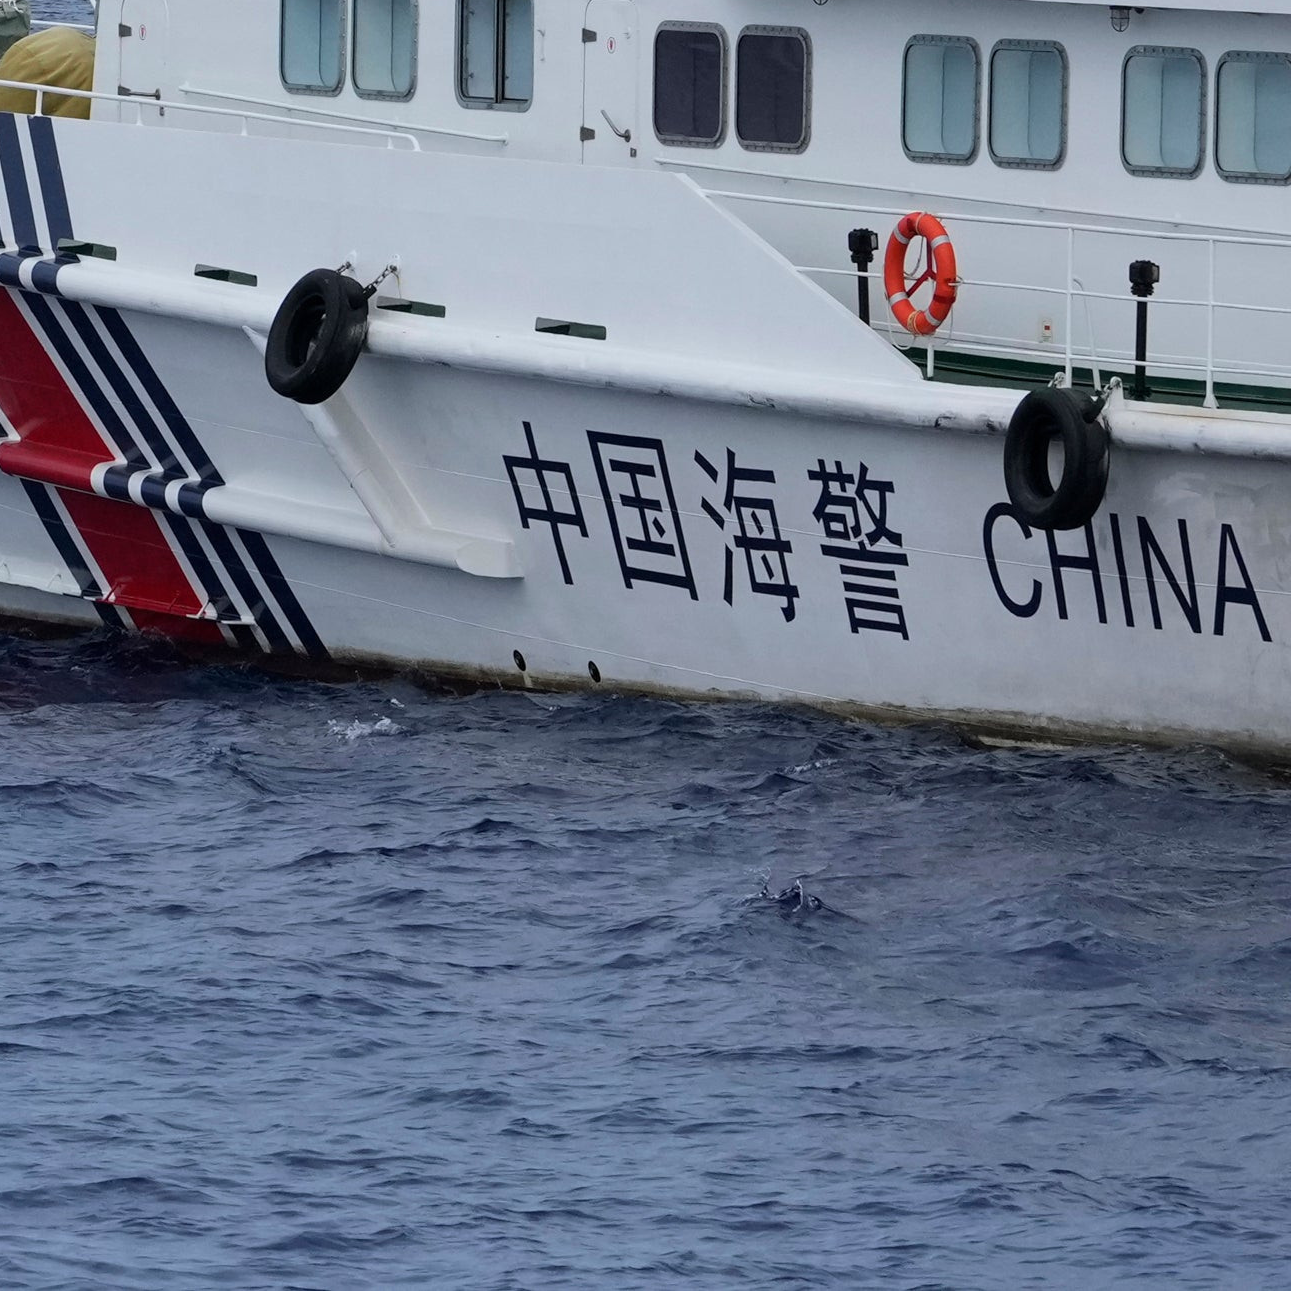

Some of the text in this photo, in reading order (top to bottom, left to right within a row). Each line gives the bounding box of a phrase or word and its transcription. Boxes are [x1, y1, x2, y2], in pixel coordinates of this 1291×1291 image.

[502, 421, 1273, 642] 中国海警 CHINA
